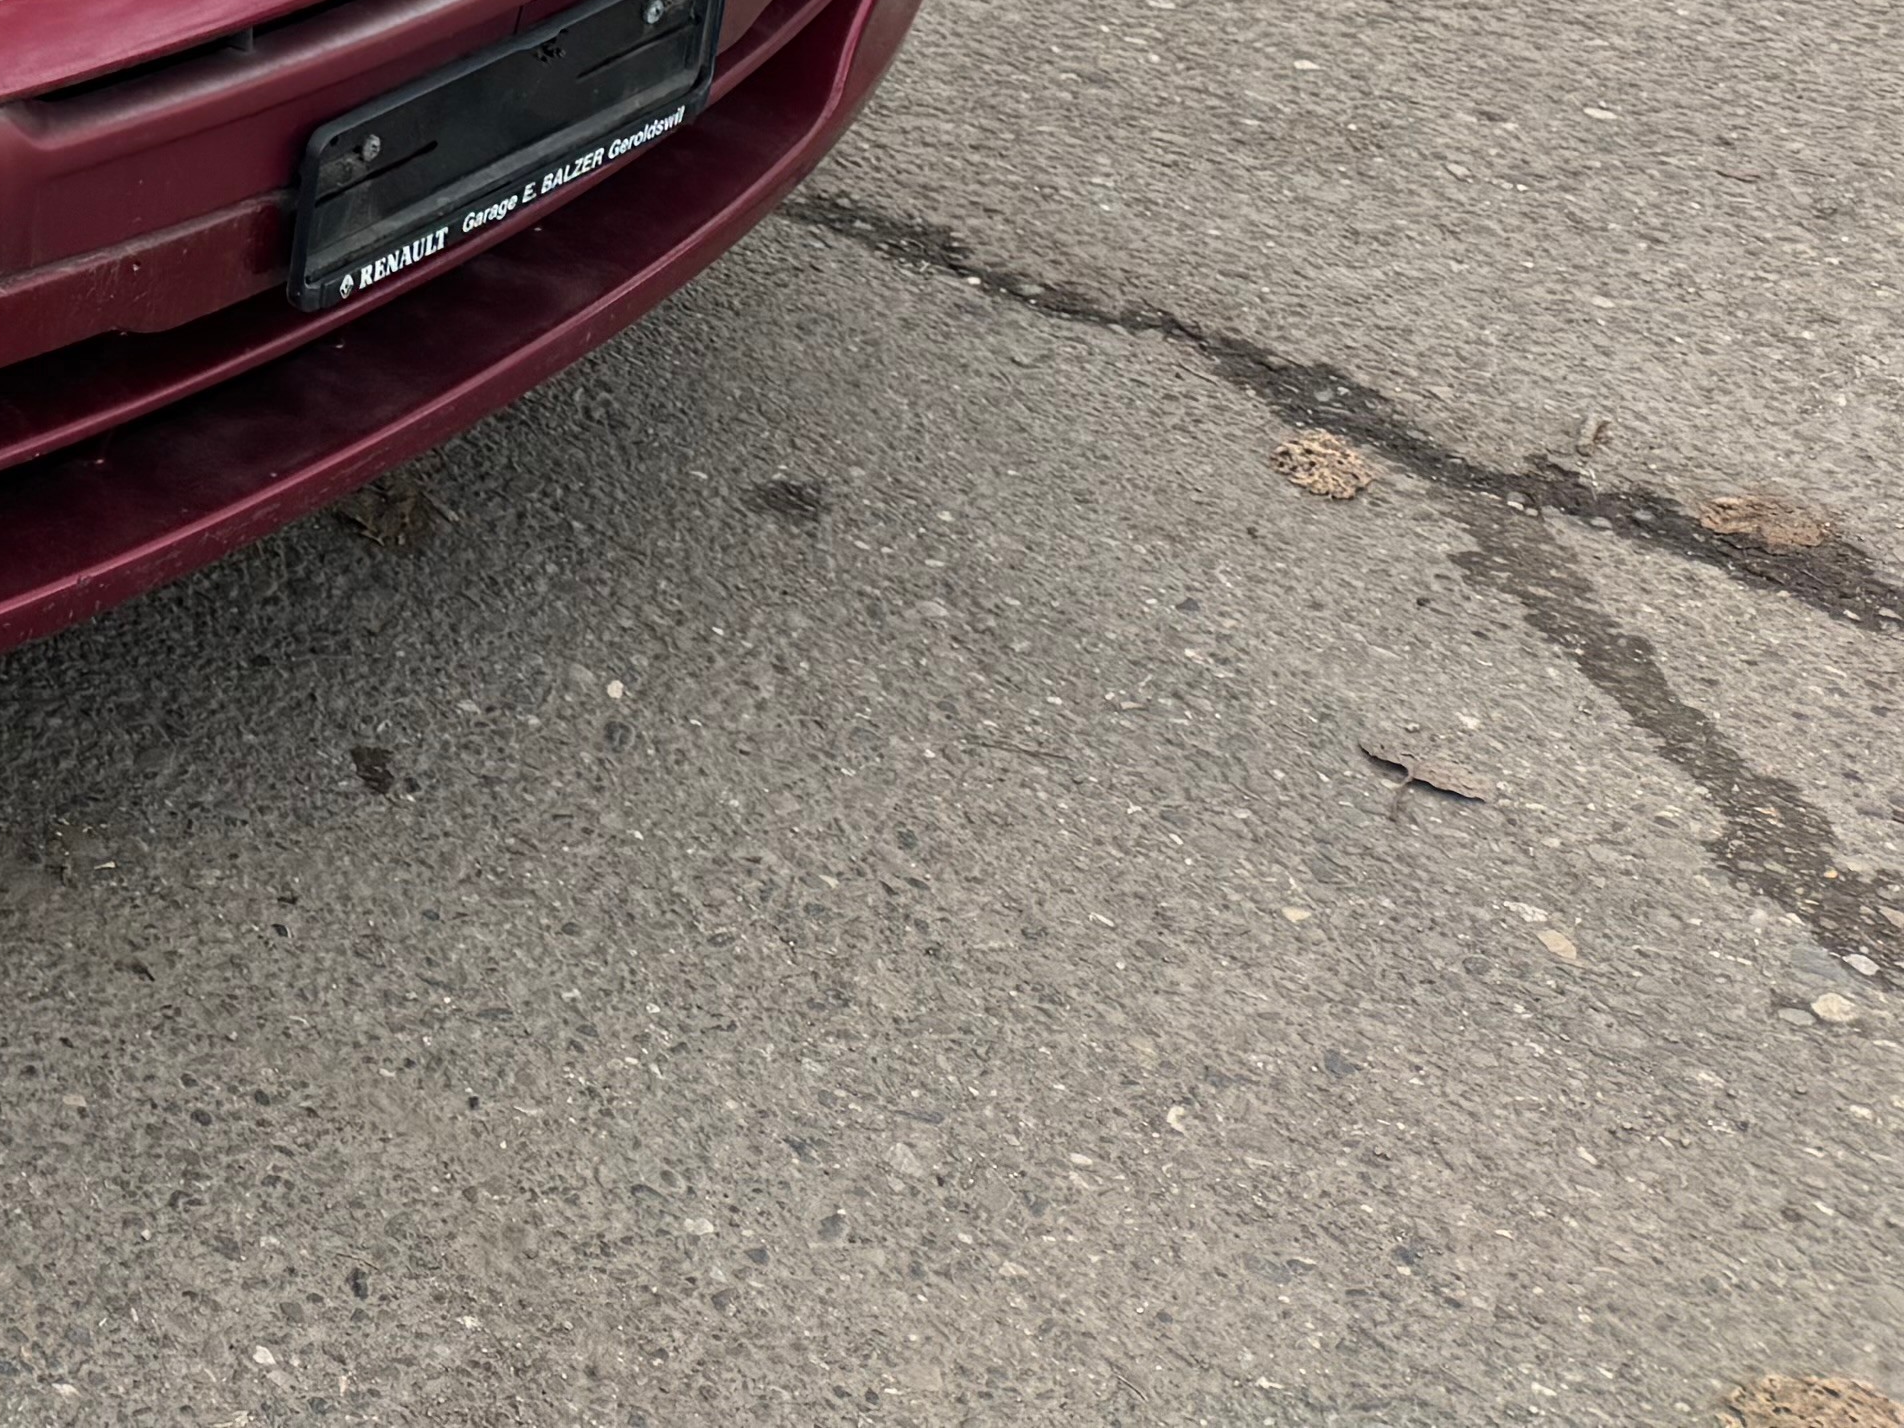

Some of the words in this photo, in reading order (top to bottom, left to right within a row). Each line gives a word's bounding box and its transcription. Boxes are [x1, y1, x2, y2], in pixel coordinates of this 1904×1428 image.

[359, 226, 449, 290] RENAULT
[462, 192, 518, 233] Garage
[541, 147, 605, 195] BALZER
[607, 104, 686, 160] Geroldswil
